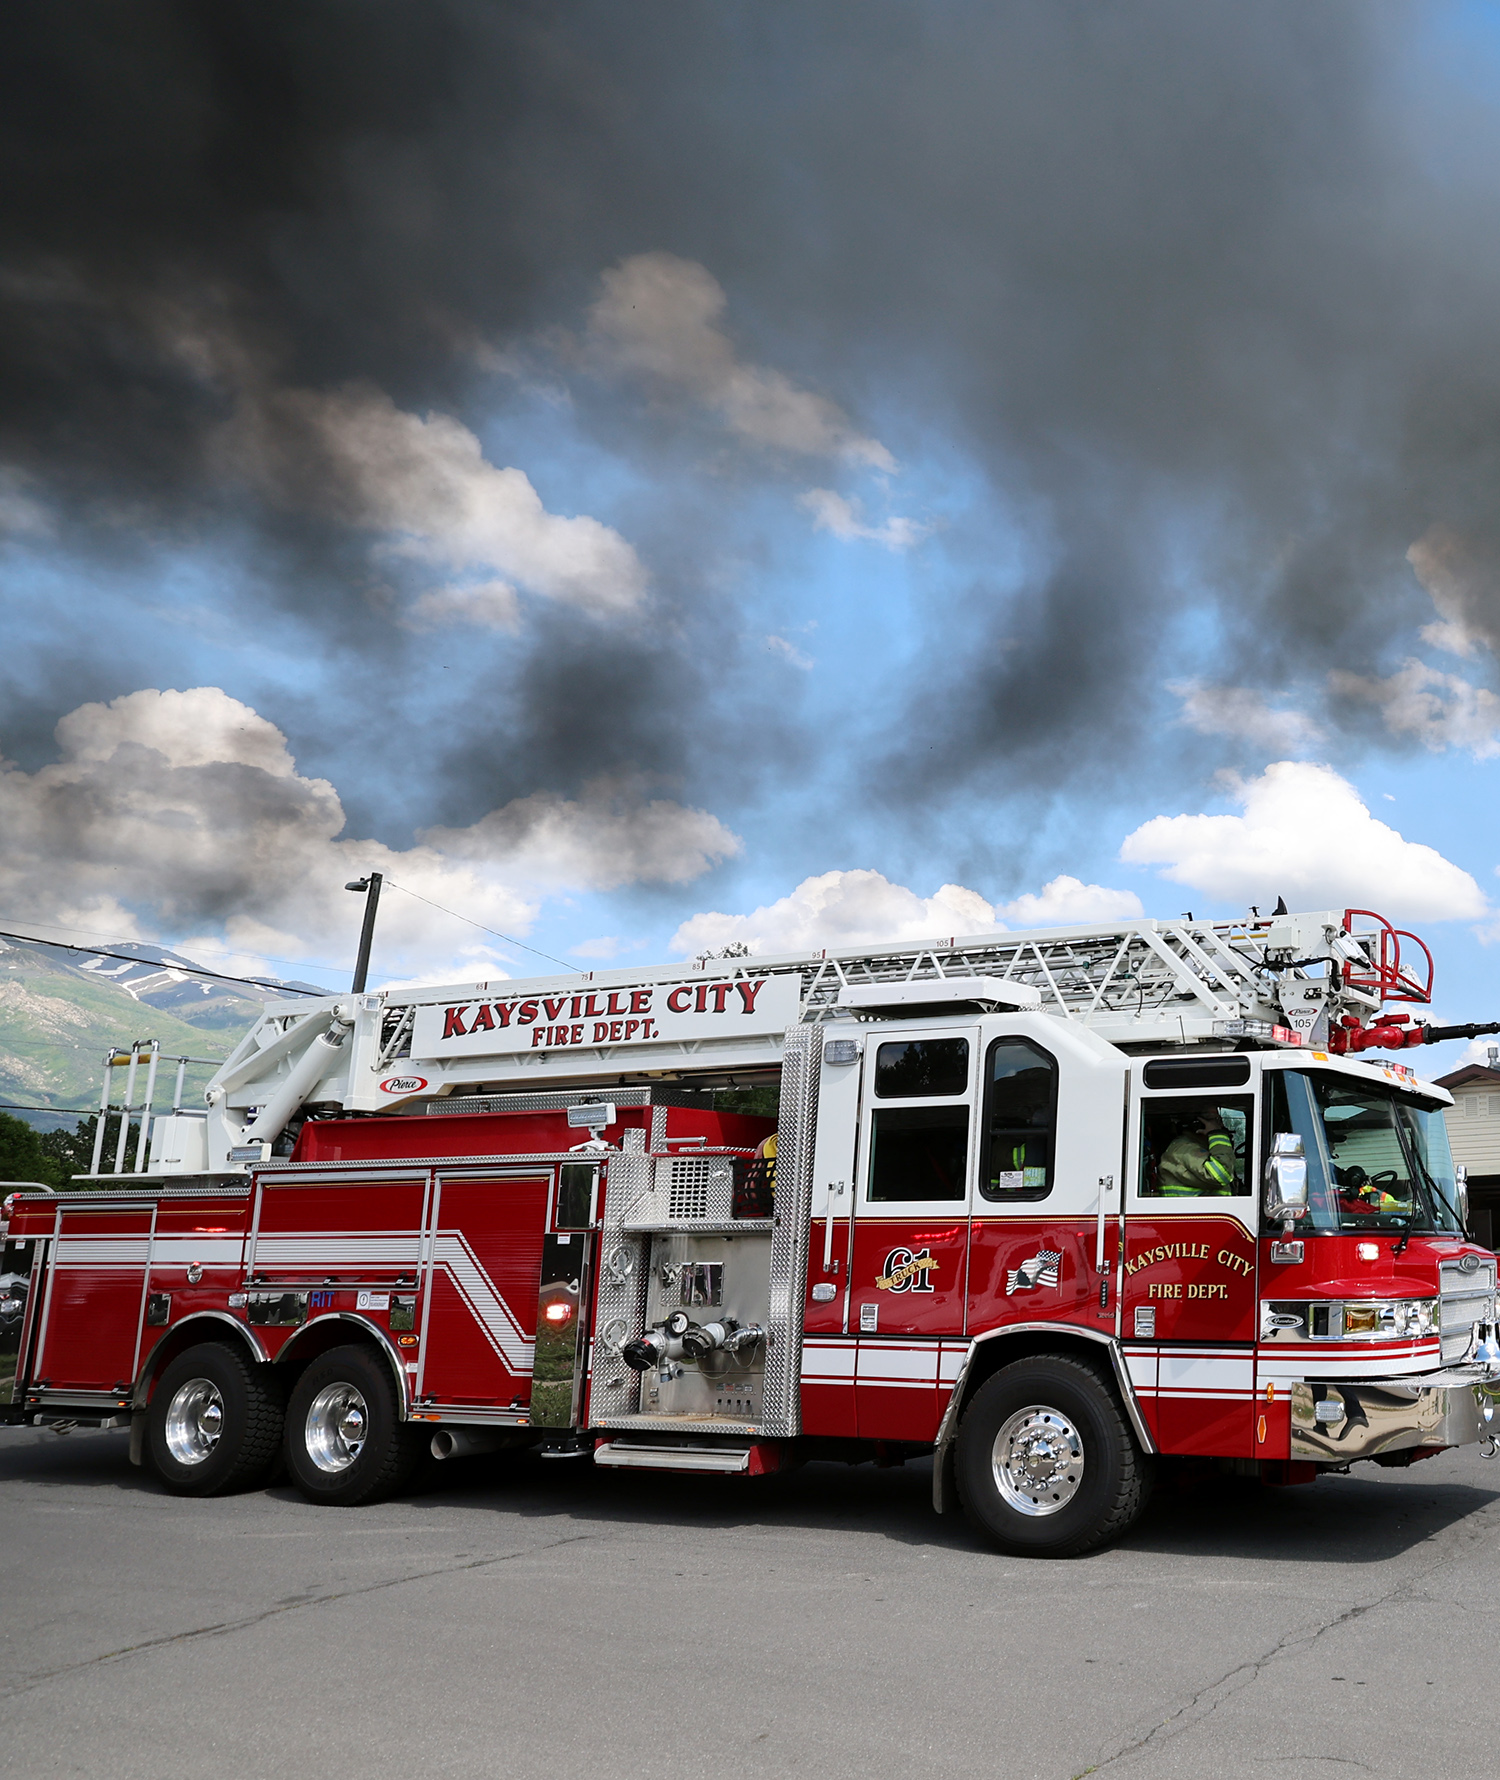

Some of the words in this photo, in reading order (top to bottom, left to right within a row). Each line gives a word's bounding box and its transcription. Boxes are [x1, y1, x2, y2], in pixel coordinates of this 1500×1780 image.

[811, 951, 821, 959] 95
[441, 989, 653, 1040] KAYSVILLE
[667, 980, 767, 1015] CITY
[531, 1023, 584, 1048] FIRE
[592, 1018, 660, 1043] DEPT.
[389, 1079, 418, 1091] Pierce
[883, 1246, 934, 1294] 61
[1124, 1243, 1211, 1276] KAYSVILLE
[1217, 1249, 1255, 1277] CITY
[891, 1262, 921, 1285] TRUCK
[311, 1291, 335, 1308] RIT
[1148, 1284, 1183, 1299] FIRE
[1187, 1284, 1229, 1299] DEPT.
